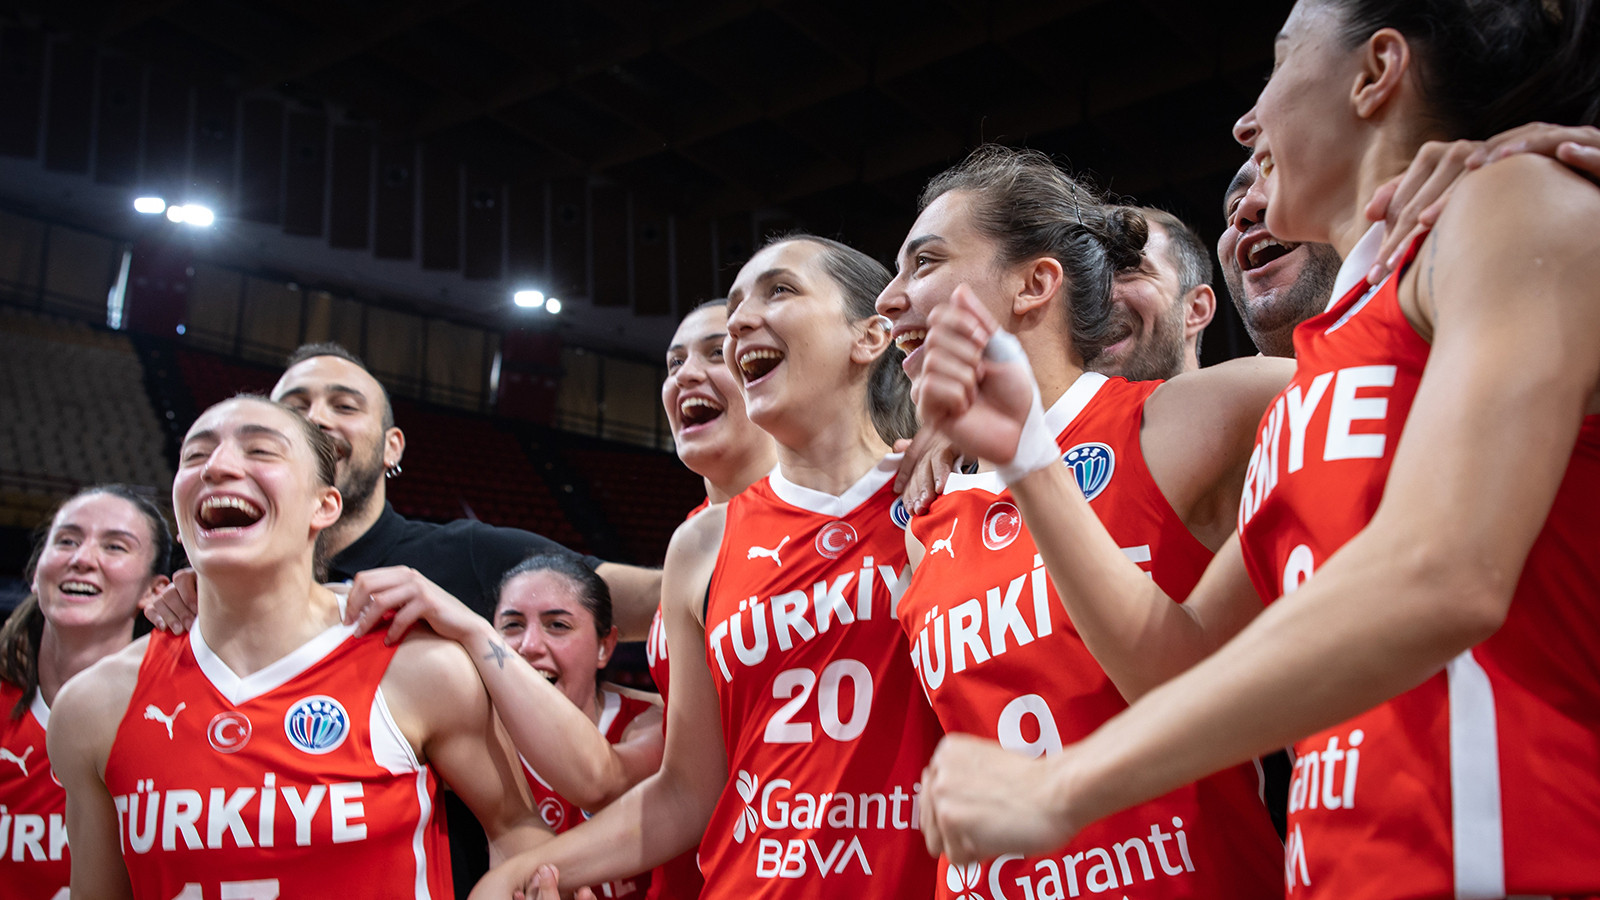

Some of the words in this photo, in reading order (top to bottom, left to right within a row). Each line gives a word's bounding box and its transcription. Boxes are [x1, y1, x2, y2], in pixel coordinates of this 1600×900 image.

[709, 556, 912, 683] TÜRKİY
[763, 658, 873, 744] 20
[998, 693, 1064, 760] 9
[113, 772, 368, 855] TÜRKİYE
[761, 778, 922, 830] Garanti
[756, 834, 873, 879] BBVA
[988, 813, 1196, 900] Garanti
